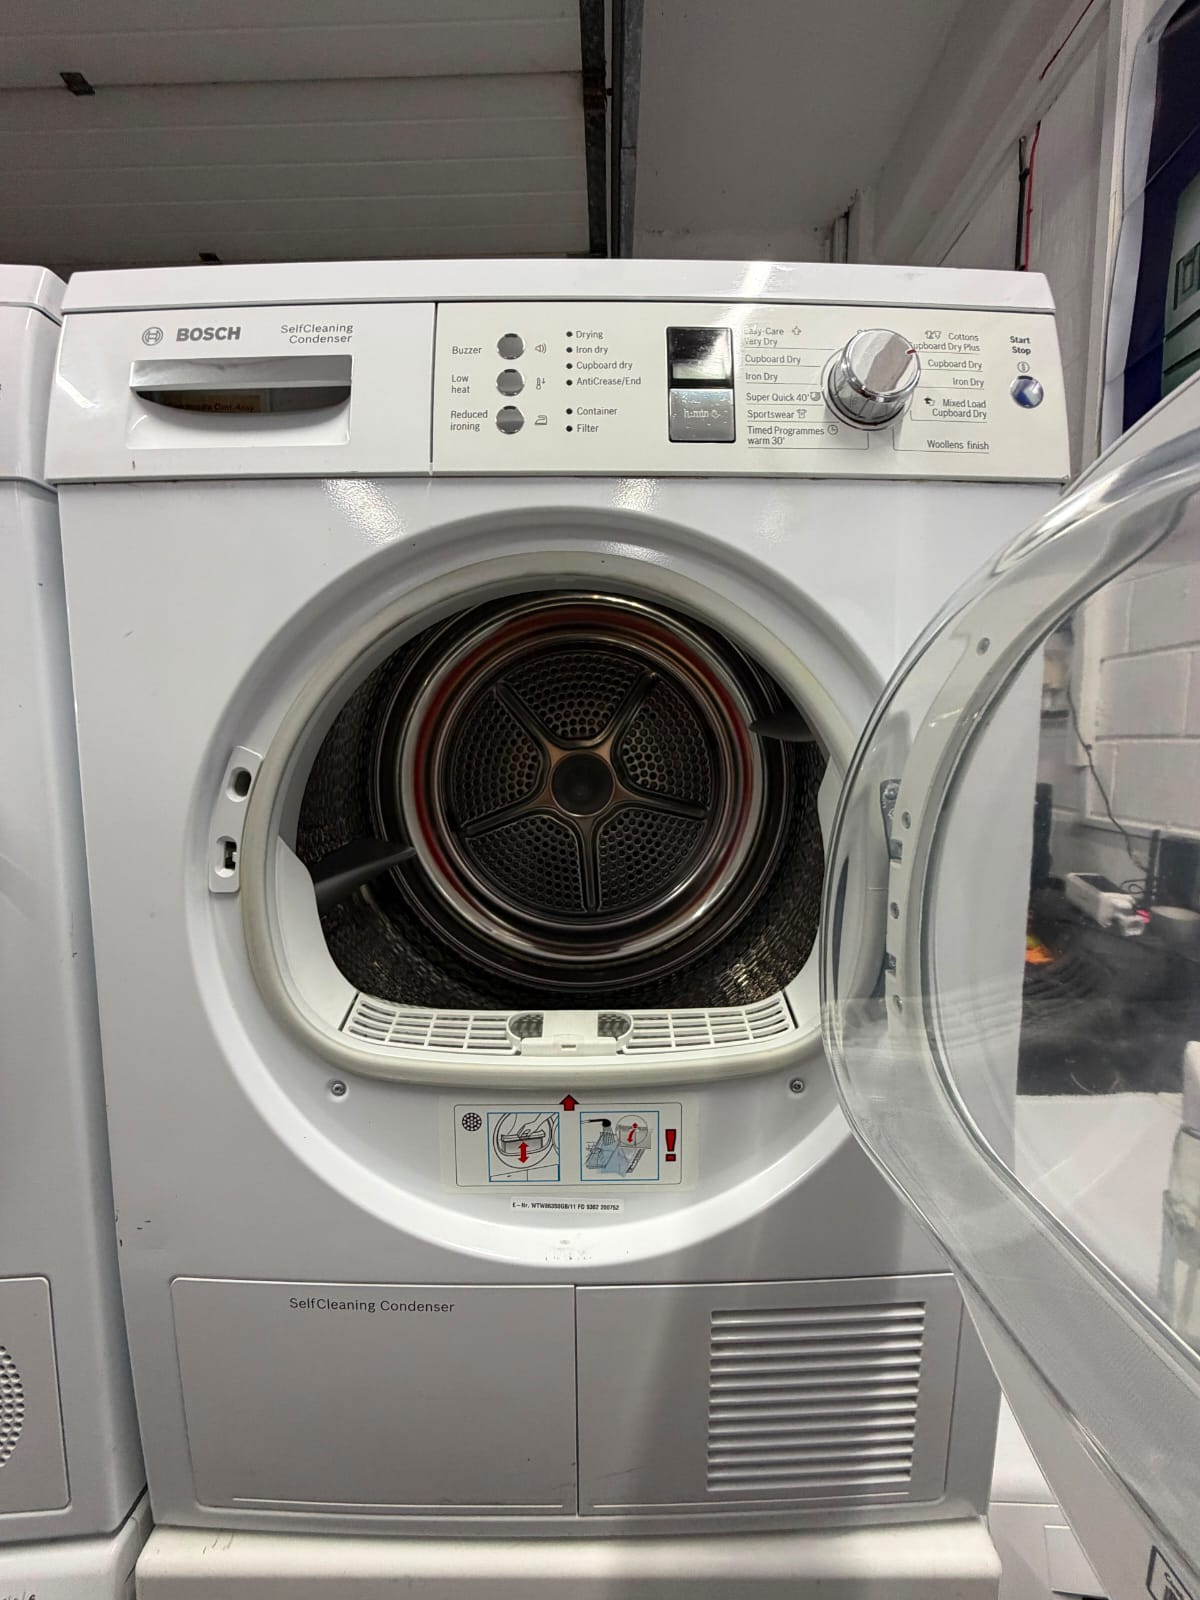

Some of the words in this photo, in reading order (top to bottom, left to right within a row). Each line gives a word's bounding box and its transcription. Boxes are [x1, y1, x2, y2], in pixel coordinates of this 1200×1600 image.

[176, 326, 242, 342] BOSCH
[281, 324, 353, 334] SelfCleaning
[289, 334, 352, 344] Condenser
[576, 330, 604, 340] Drying
[948, 332, 979, 342] Cottons
[1009, 335, 1031, 344] Start
[763, 338, 778, 347] Dry
[911, 342, 946, 352] upboard
[947, 342, 962, 353] Dry
[963, 343, 980, 352] Plus
[451, 346, 482, 355] Buzzer
[576, 346, 592, 354] Iron
[594, 345, 609, 356] dry
[1011, 346, 1032, 356] Stop
[745, 354, 785, 364] Cupboard
[786, 355, 801, 365] Dry
[576, 361, 617, 371] Cupboard
[619, 361, 633, 371] dry
[927, 359, 967, 369] Cupboard
[967, 361, 983, 371] Dry
[451, 374, 469, 383] Low
[576, 376, 642, 386] AntiCrease/End
[745, 372, 762, 381] Iron
[763, 372, 778, 382] Dry
[952, 377, 969, 386] Iron
[969, 378, 984, 388] Dry
[451, 385, 470, 394] heat
[746, 392, 770, 402] Super
[771, 393, 795, 402] Quick
[942, 398, 966, 408] Mixed
[967, 399, 987, 409] Load
[450, 411, 488, 420] Reduced
[576, 406, 618, 416] Container
[747, 409, 795, 420] Sportswear
[932, 408, 972, 418] Cupboard
[972, 410, 987, 420] Dry
[450, 422, 480, 432] ironing
[576, 423, 600, 433] Filter
[747, 425, 773, 435] Timed
[774, 426, 825, 437] Programmes
[927, 439, 965, 450] Woollens
[967, 441, 990, 450] finish
[289, 1297, 376, 1313] SelfCleaning
[380, 1299, 456, 1313] Condenser
